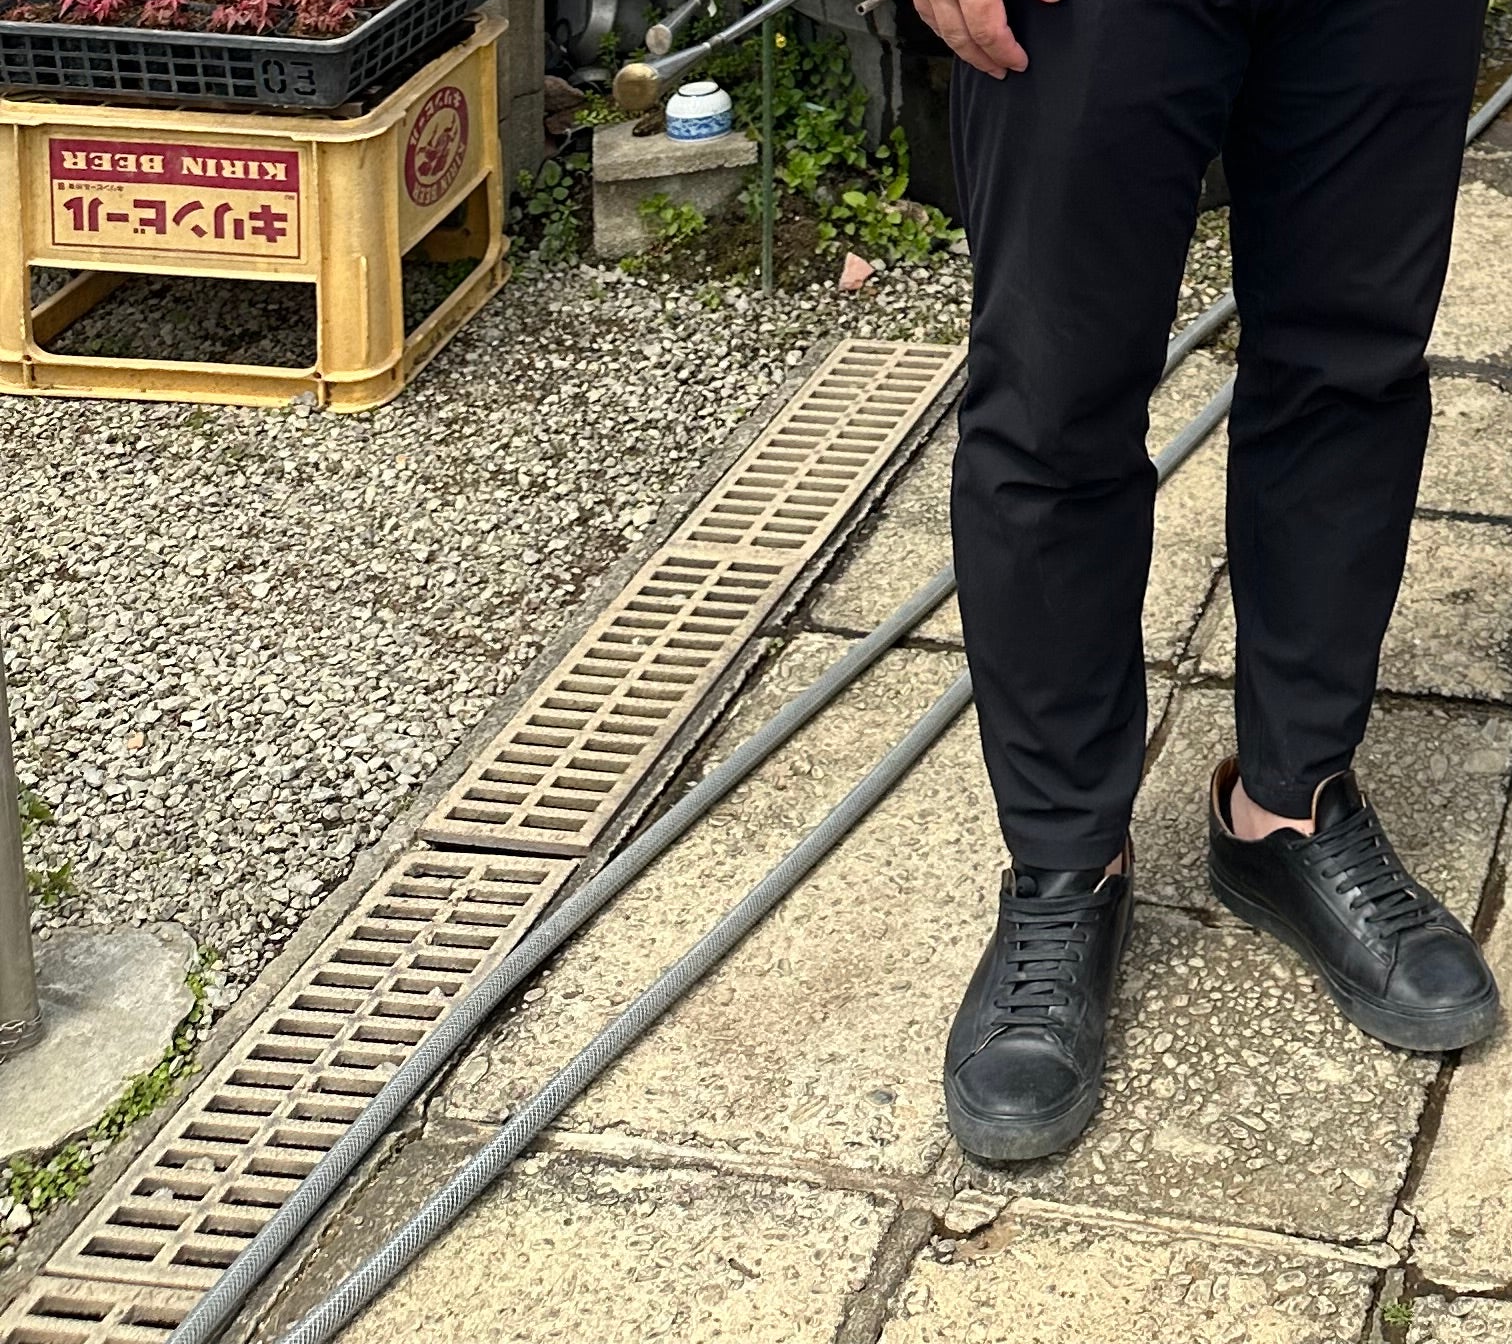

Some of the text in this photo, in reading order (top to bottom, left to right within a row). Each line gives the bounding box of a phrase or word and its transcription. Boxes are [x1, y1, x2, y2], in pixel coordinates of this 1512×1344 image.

[61, 151, 287, 181] KIRIN BEER
[63, 196, 288, 243] キリンビール
